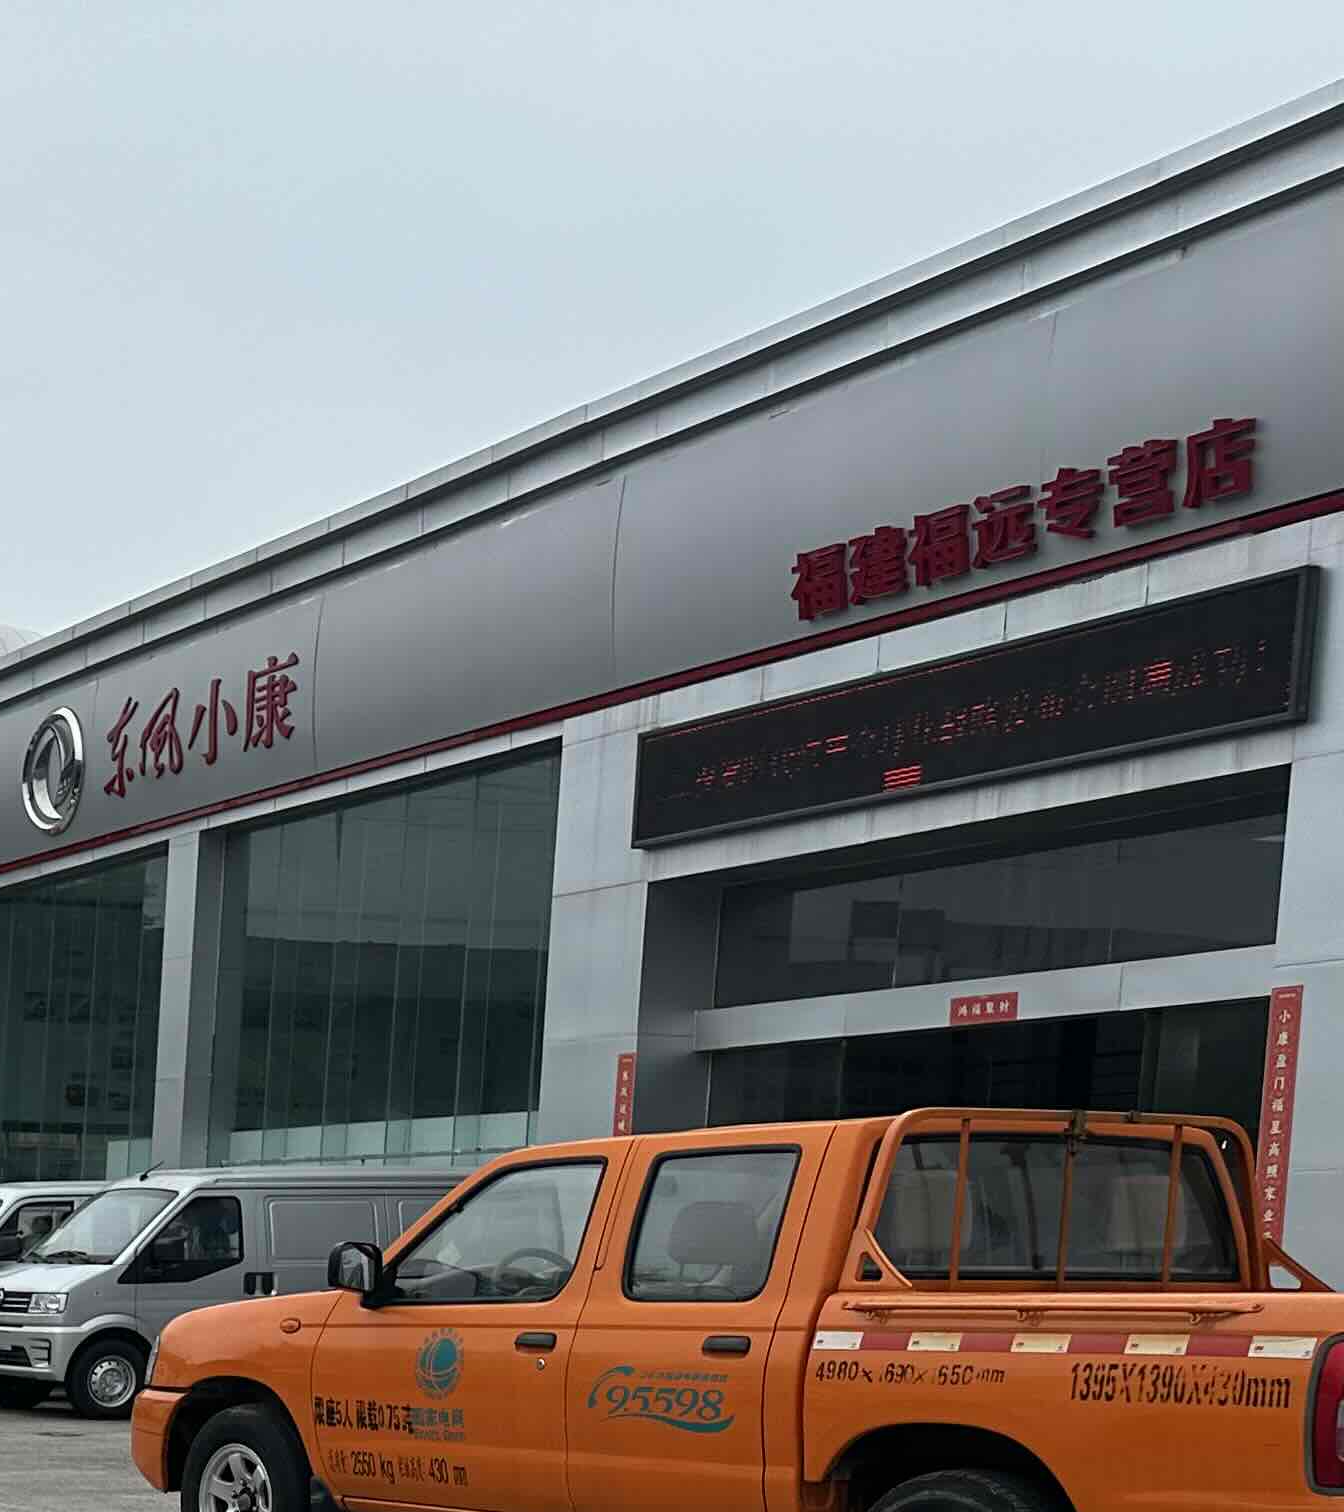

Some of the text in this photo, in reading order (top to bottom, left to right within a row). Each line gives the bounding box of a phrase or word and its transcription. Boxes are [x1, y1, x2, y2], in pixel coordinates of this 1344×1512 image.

[791, 417, 1257, 620] 福建福远专营店
[104, 652, 299, 798] 东风小康
[606, 1385, 724, 1421] 95598
